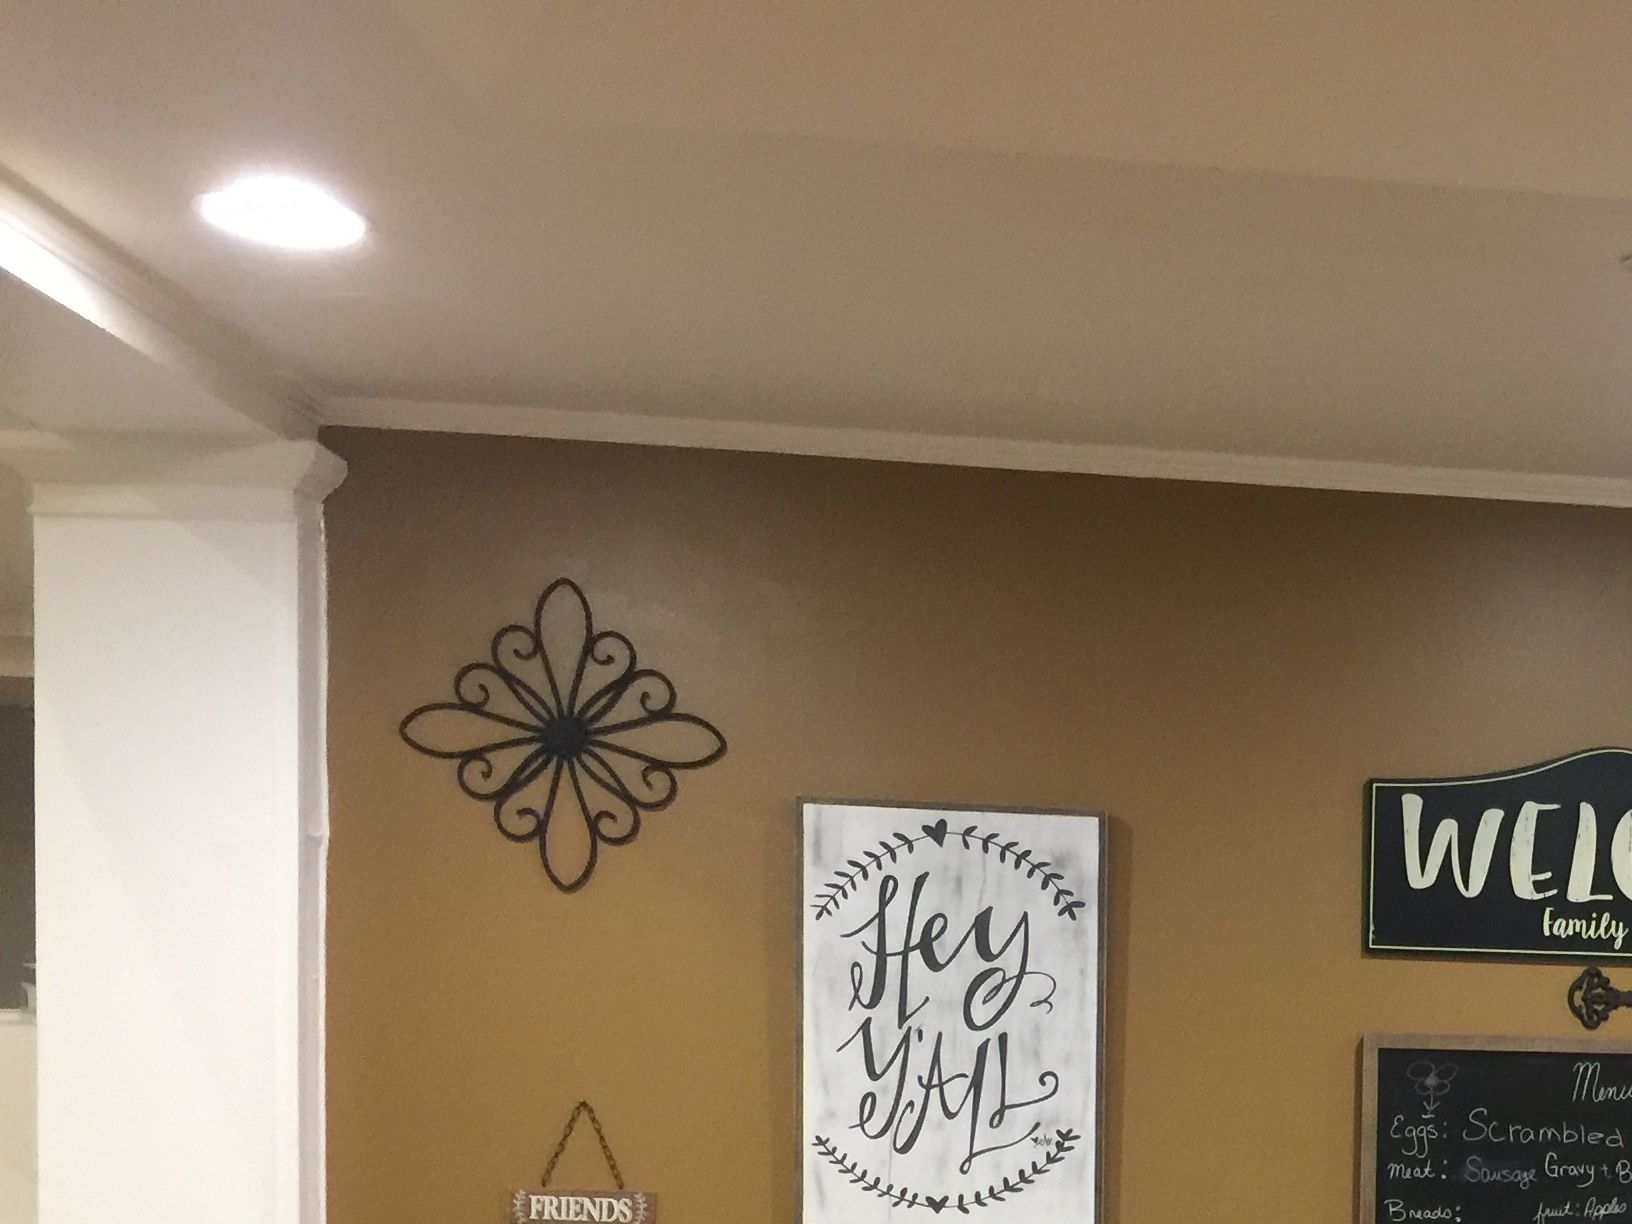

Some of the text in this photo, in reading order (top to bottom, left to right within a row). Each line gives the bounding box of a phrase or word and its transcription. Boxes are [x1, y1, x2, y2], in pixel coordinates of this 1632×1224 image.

[1543, 907, 1629, 950] Family
[840, 871, 1057, 1032] Hey
[836, 1016, 1060, 1175] Y'ALL
[1462, 1107, 1625, 1149] Scrambled
[1464, 1155, 1537, 1189] Sausage
[1544, 1151, 1595, 1188] Gravy
[529, 1194, 633, 1224] FRIENDS
[1583, 1197, 1628, 1221] Apples
